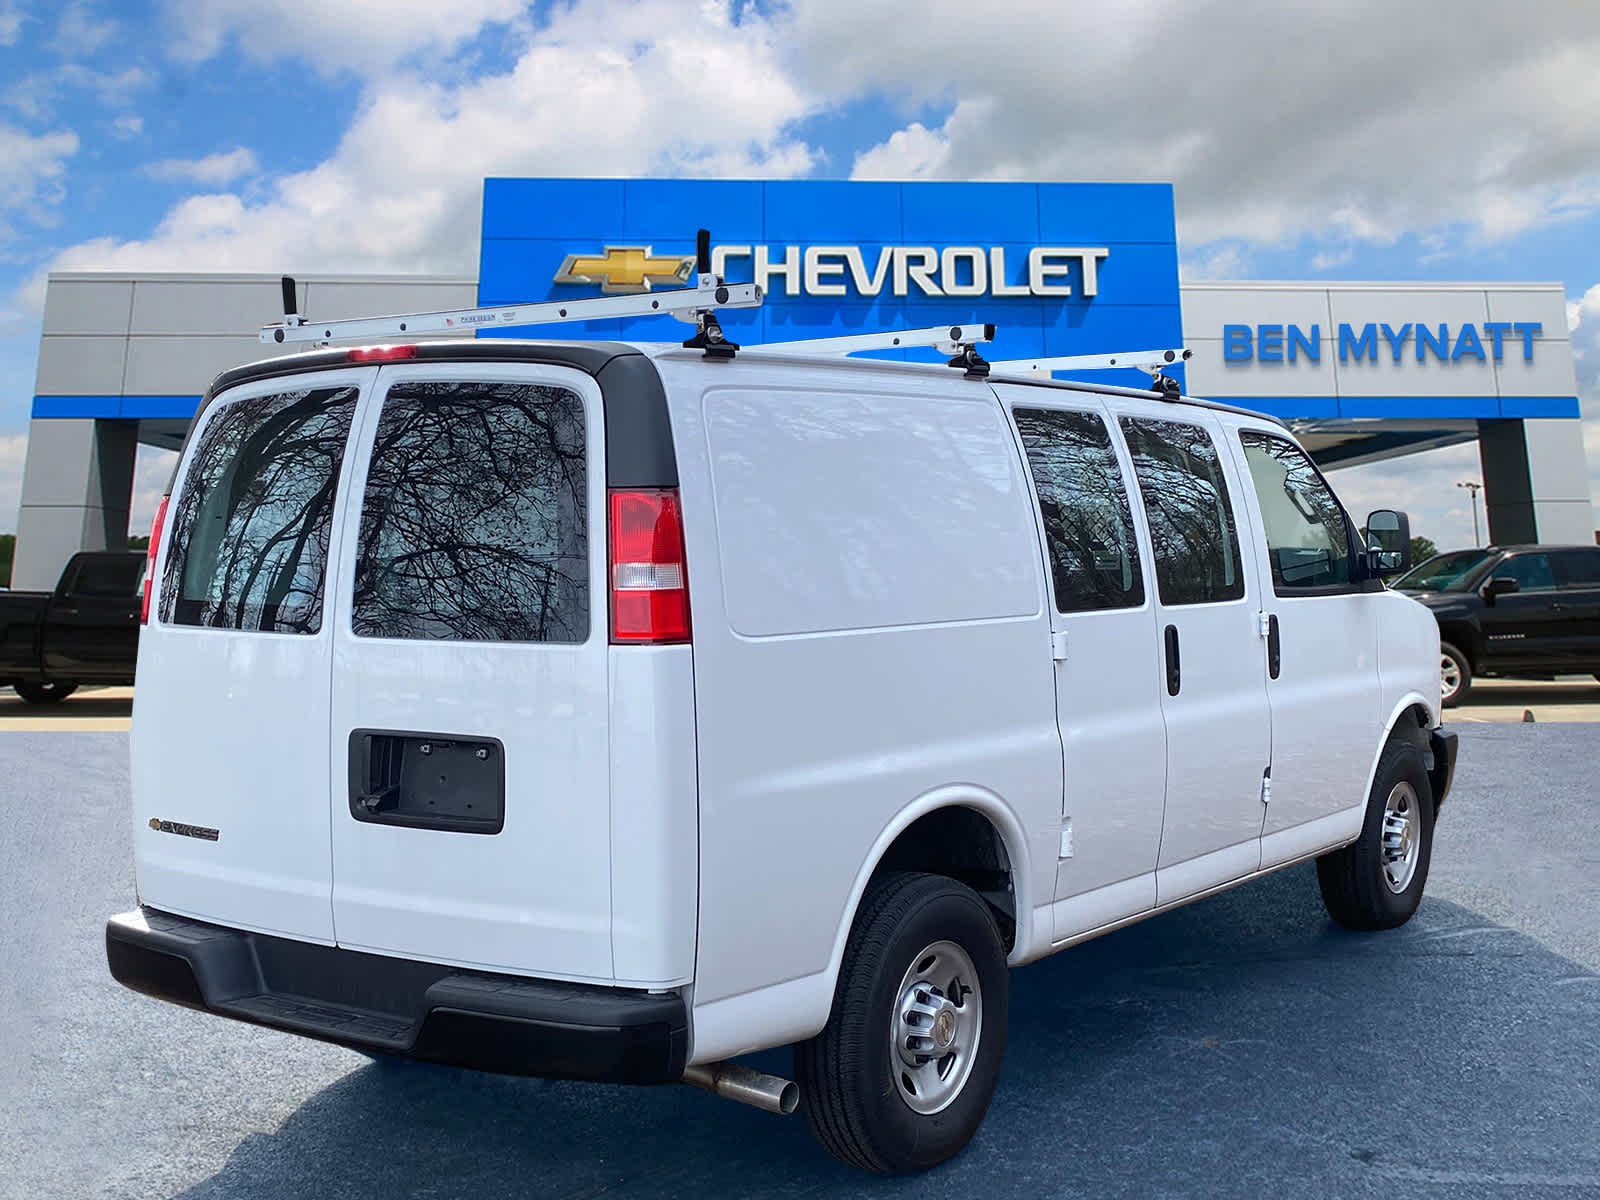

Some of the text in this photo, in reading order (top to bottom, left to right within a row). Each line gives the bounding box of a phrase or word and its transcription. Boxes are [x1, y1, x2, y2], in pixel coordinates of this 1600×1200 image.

[711, 245, 1109, 297] CHEVROLET
[1223, 322, 1542, 364] BEN MYNATT
